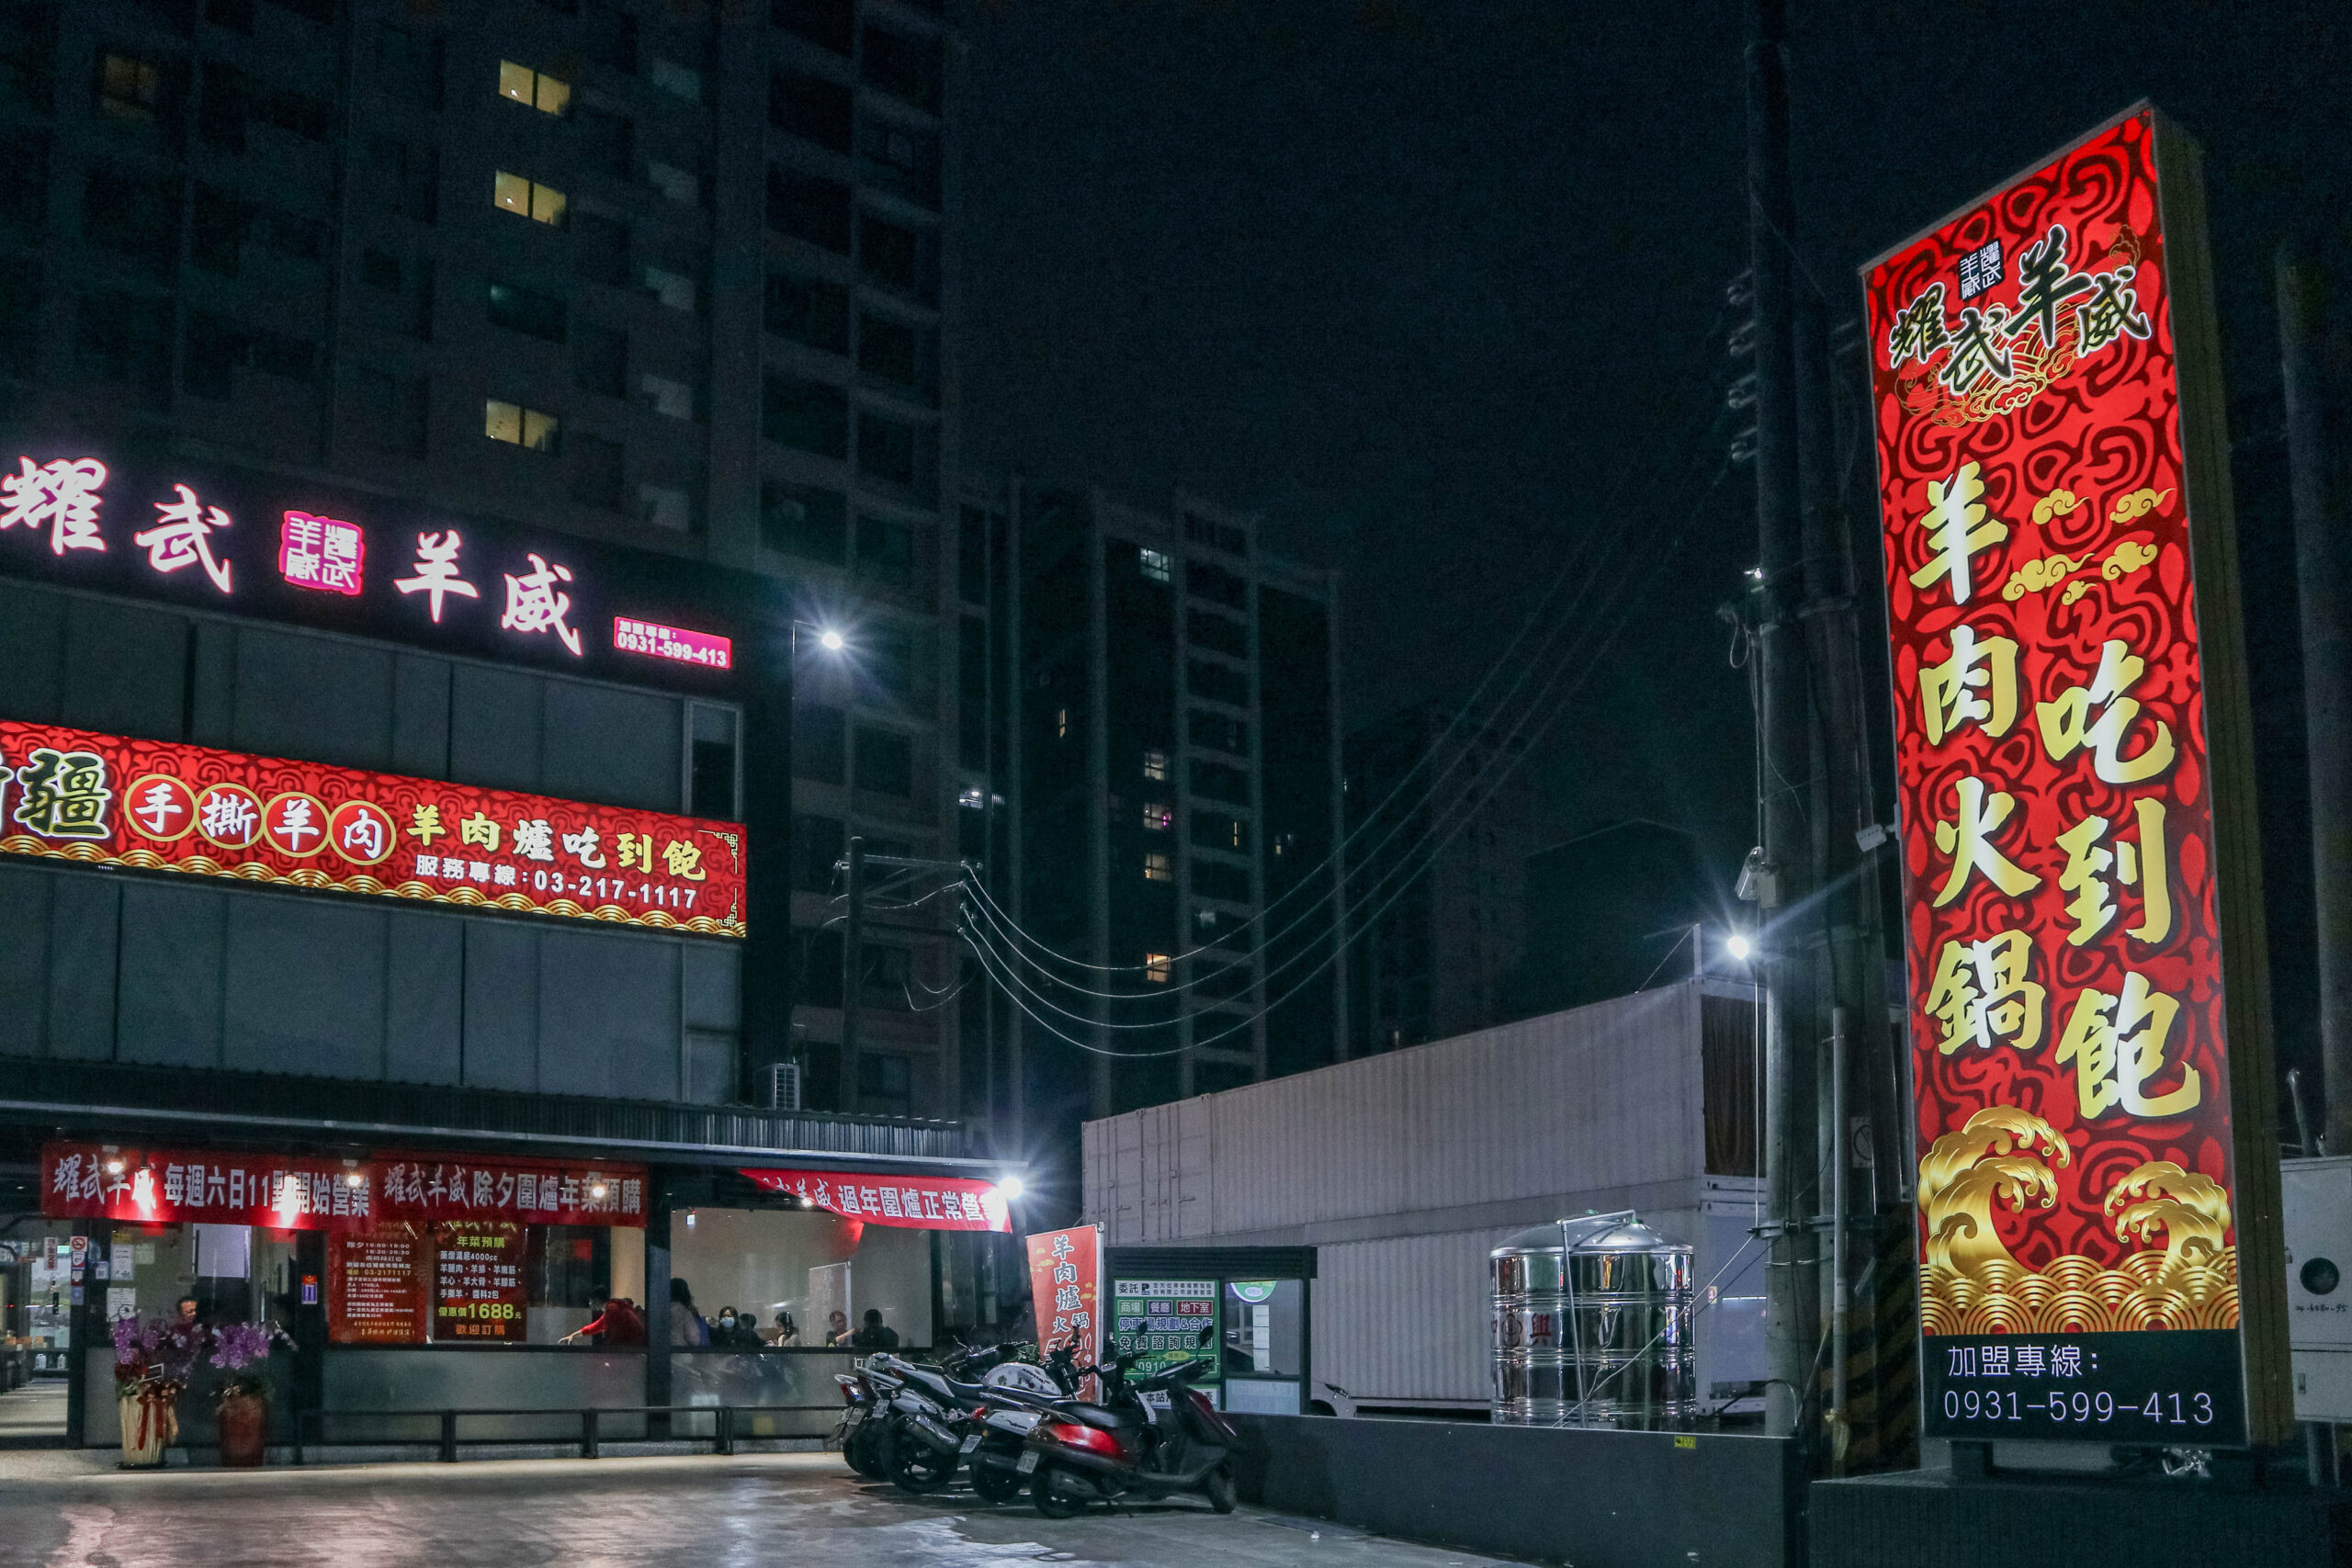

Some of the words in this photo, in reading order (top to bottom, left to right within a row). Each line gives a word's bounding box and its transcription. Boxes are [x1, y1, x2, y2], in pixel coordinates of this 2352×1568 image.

[1889, 223, 2153, 397] 耀武羊威
[1, 457, 233, 594] 耀武
[394, 529, 584, 657] 羊威
[617, 631, 727, 667] 0931-599-413
[1909, 460, 2047, 1056] 羊肉火鍋
[0, 747, 113, 840] 疆
[405, 804, 707, 882] 羊肉爐吃到飽
[2035, 639, 2202, 1120] 吃到飽
[838, 1185, 1007, 1222] 過年圍爐正常營
[457, 1235, 505, 1248] 年菜預購
[1051, 1234, 1082, 1313] 羊肉爐
[1051, 1311, 1091, 1335] 火鍋
[1121, 1302, 1140, 1314] 商場
[1150, 1303, 1170, 1314] 餐廳
[1181, 1302, 1210, 1314] 地下室
[1118, 1335, 1213, 1350] 免費諮詢規
[1947, 1345, 2100, 1378] 加盟專線:
[1943, 1389, 2215, 1425] 0931-599-413
